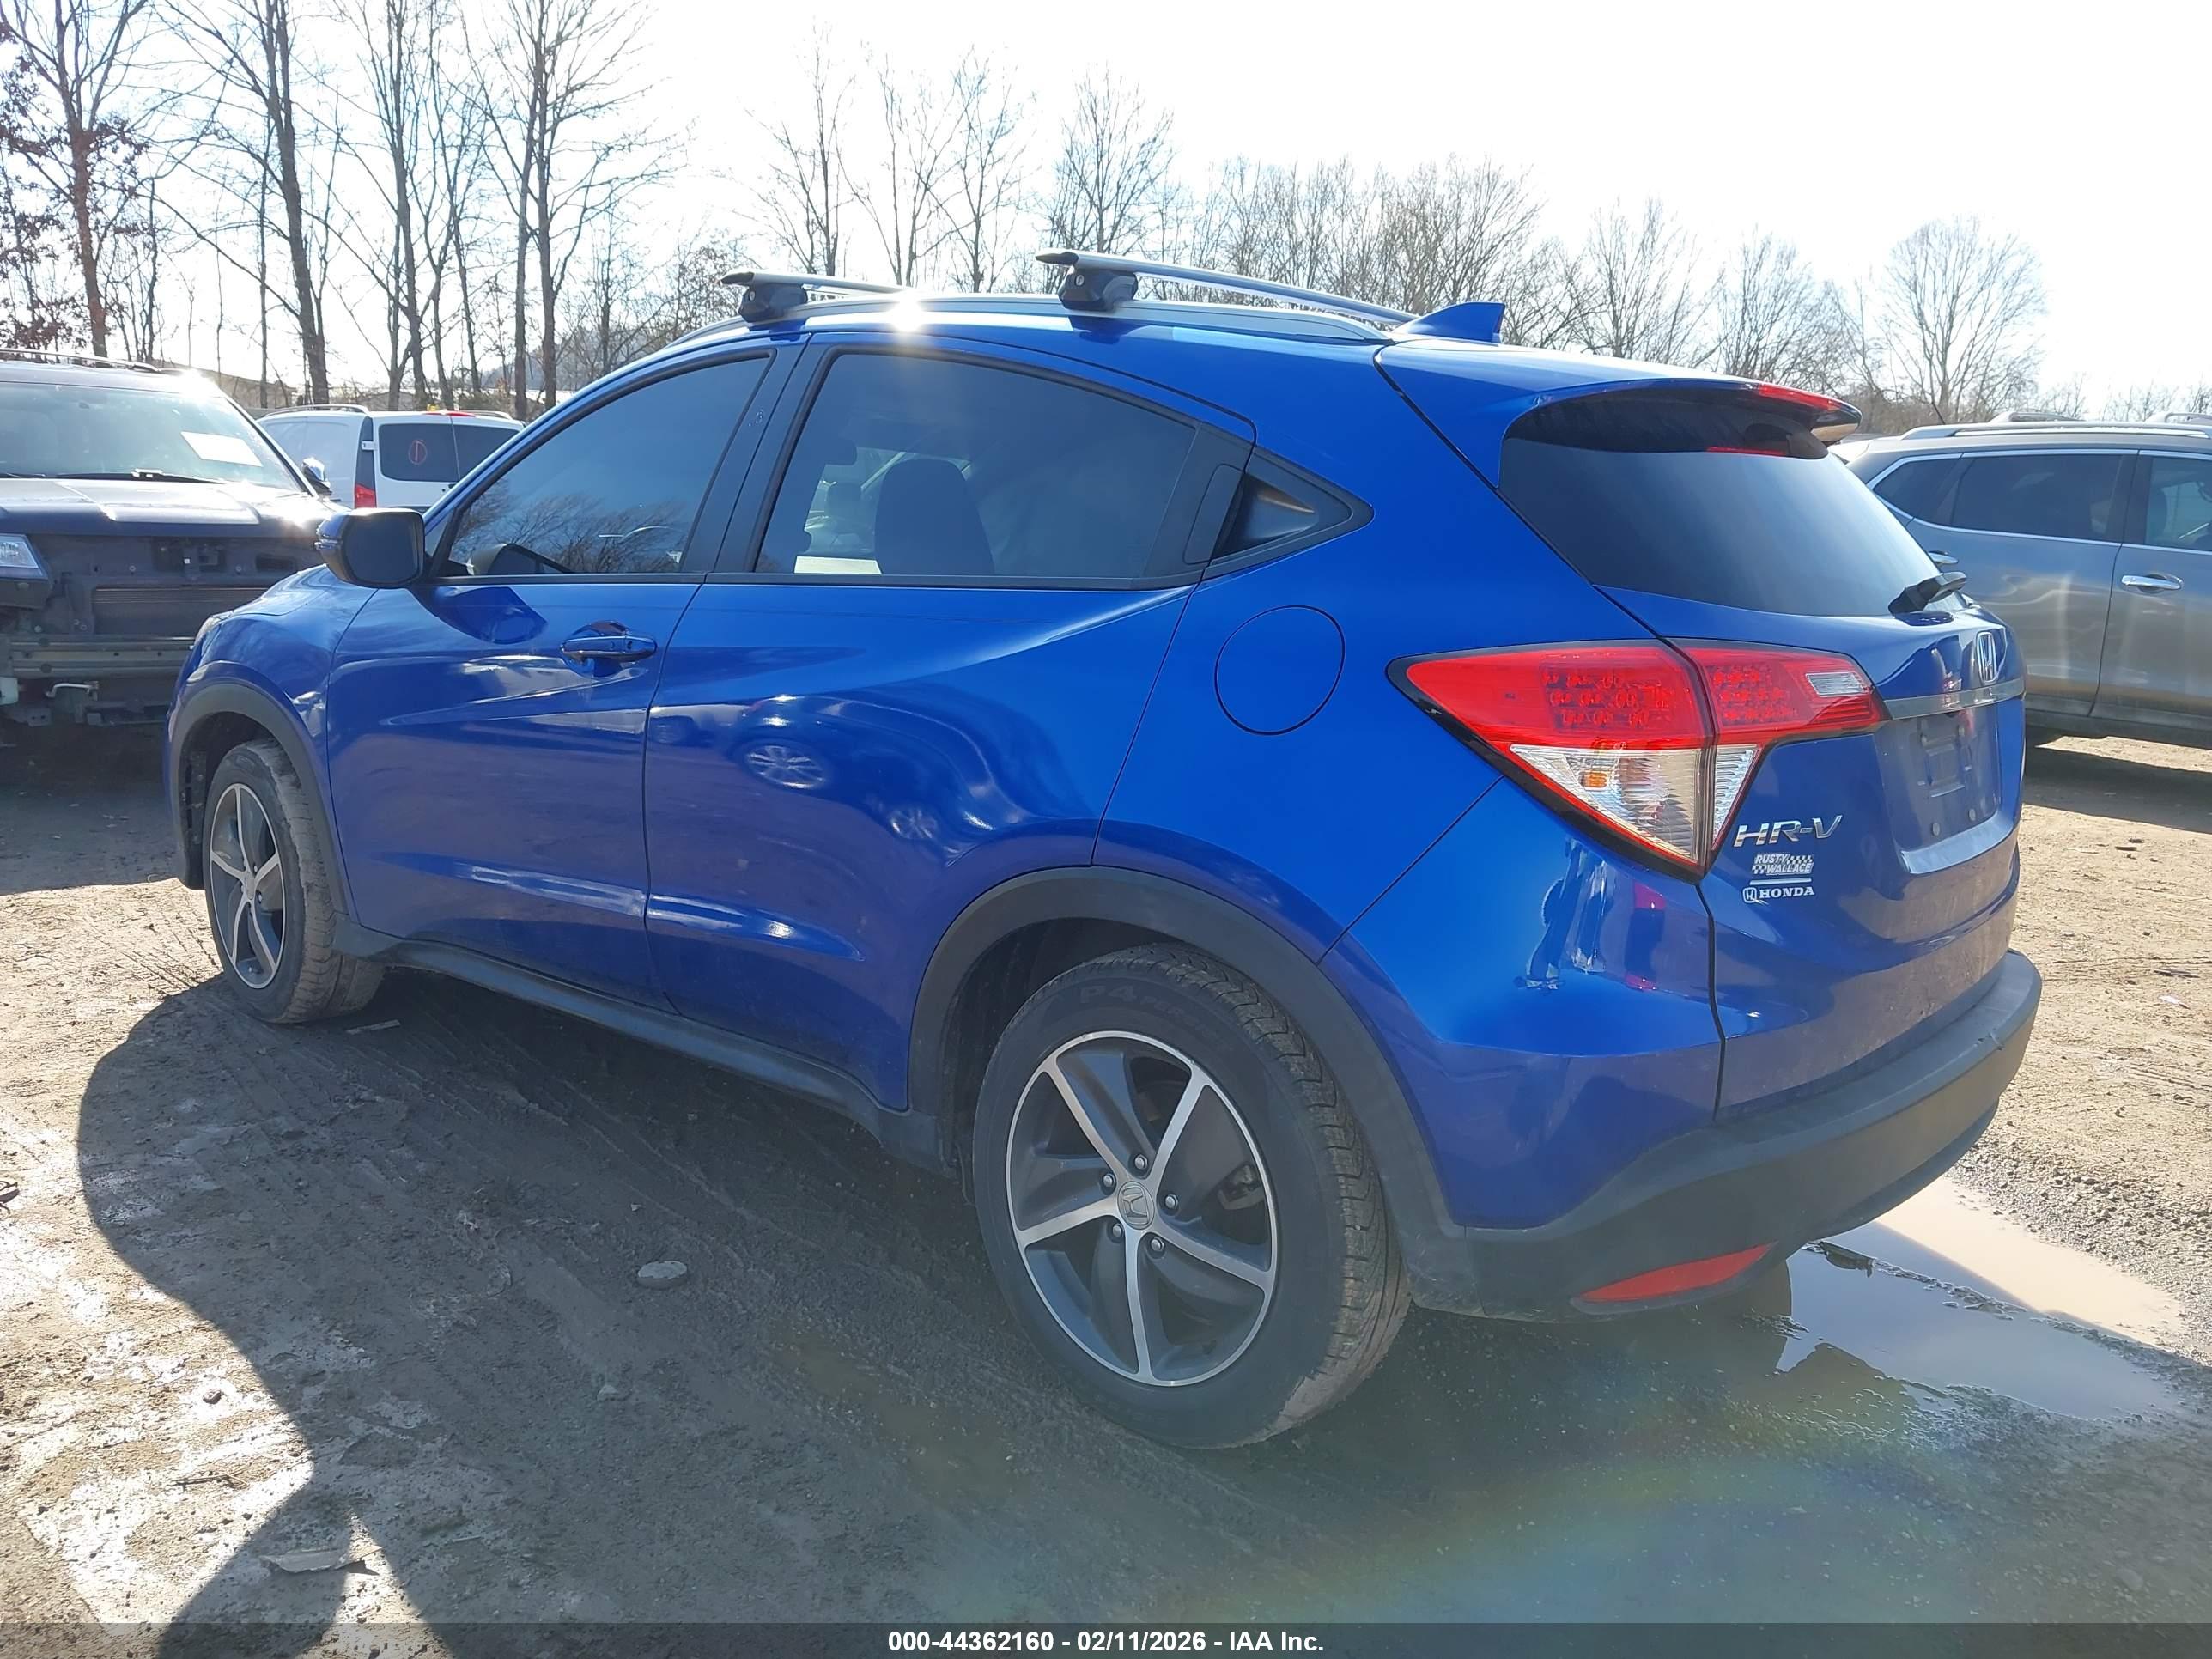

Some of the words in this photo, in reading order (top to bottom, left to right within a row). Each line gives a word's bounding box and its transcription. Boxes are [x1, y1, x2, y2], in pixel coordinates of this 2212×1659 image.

[1733, 814, 1843, 848] HR-V
[1754, 853, 1790, 865] RUSTY
[1765, 862, 1813, 874] WALLACE
[1759, 886, 1815, 899] HONDA
